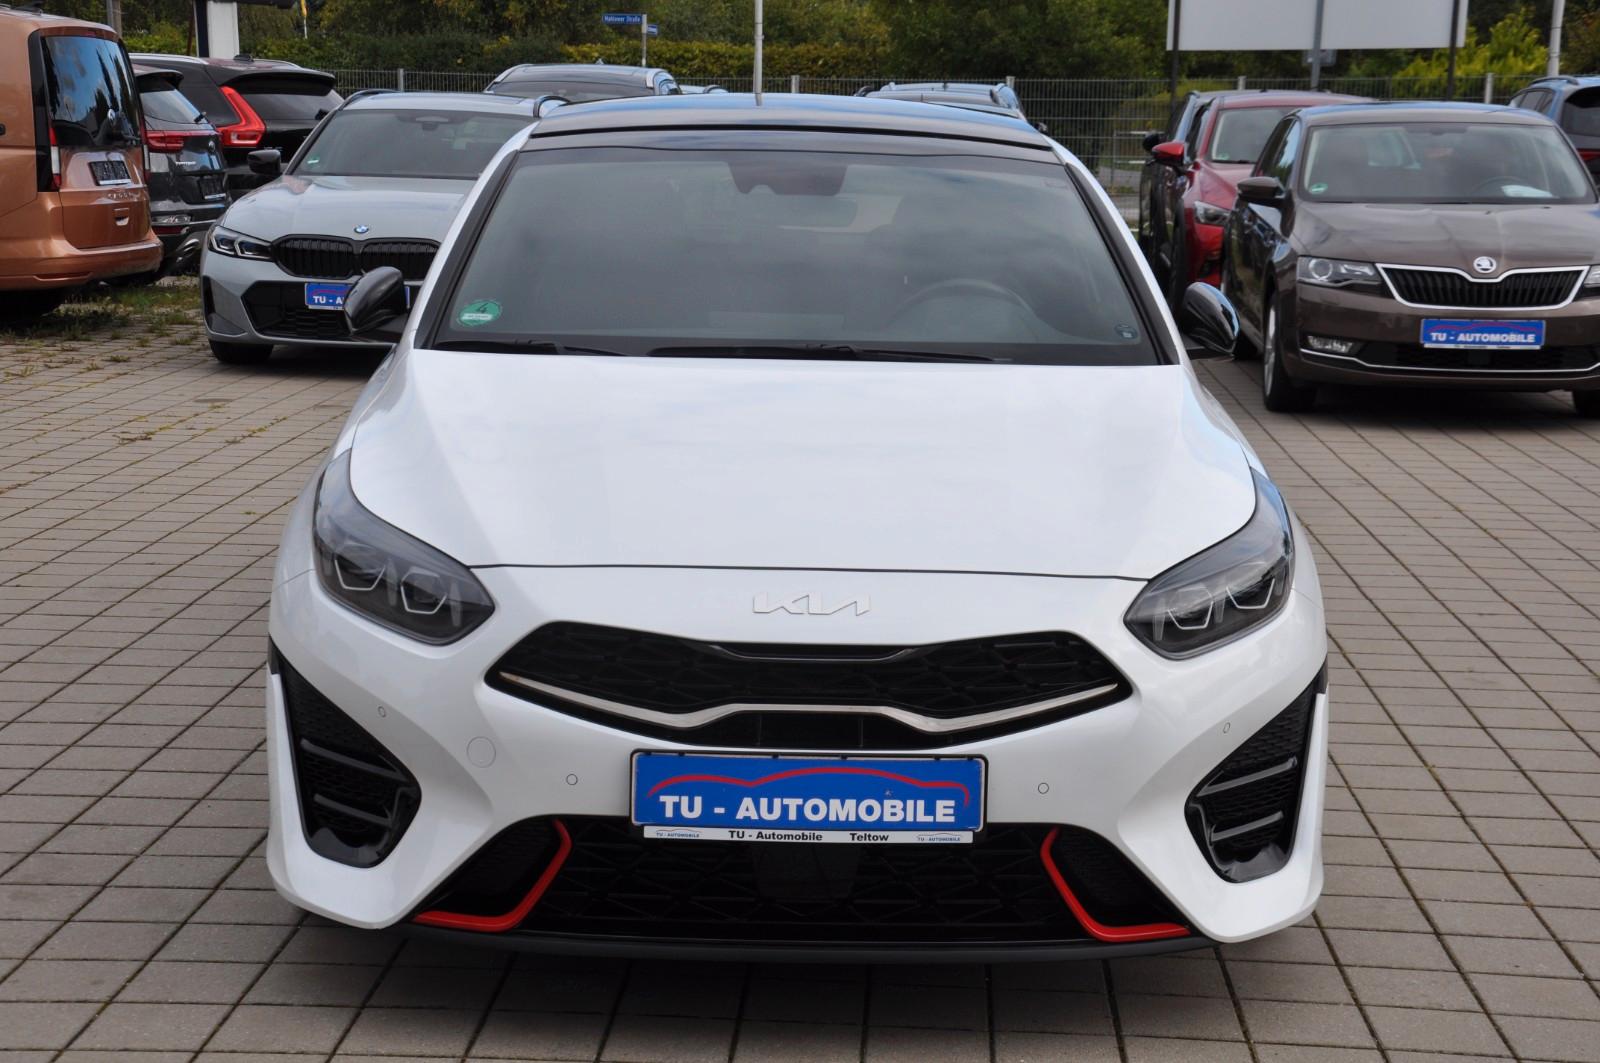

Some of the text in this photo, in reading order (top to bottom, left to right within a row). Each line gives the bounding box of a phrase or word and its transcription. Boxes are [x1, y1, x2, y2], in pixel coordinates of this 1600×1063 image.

[313, 295, 326, 304] TU
[1430, 332, 1447, 342] TU
[1457, 333, 1536, 343] AUTOMOBILE
[659, 795, 703, 819] TU
[736, 797, 956, 823] AUTOMOBILE
[728, 830, 745, 839] TU
[756, 831, 823, 841] Automobile
[849, 832, 889, 842] Teltow
